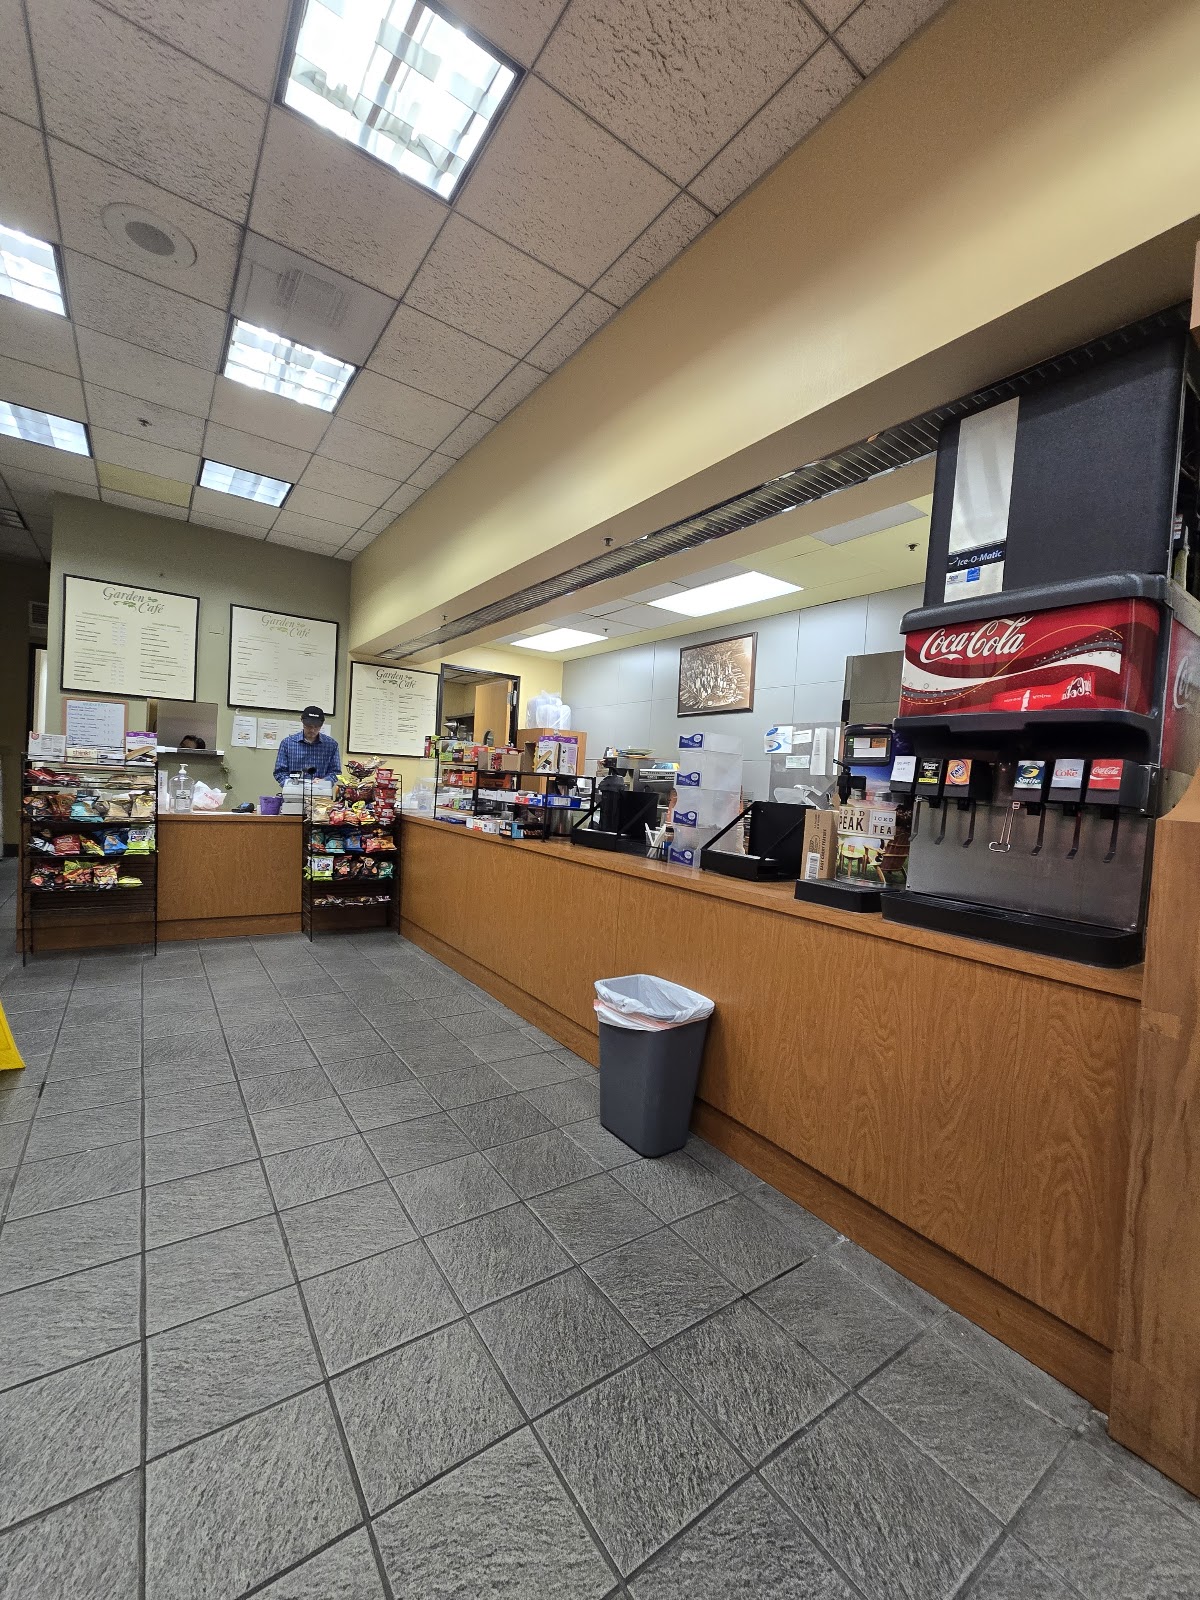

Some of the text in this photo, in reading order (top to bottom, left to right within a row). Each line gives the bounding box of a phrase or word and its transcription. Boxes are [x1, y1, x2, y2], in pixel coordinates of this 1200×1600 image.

[957, 550, 1003, 566] Ice-O-Matic
[103, 586, 145, 603] Garden
[138, 601, 165, 614] Café
[261, 614, 295, 628] Garden
[289, 627, 311, 639] Café
[919, 615, 1034, 664] Coca-Cola
[375, 668, 404, 680] Garden
[398, 679, 417, 689] Café
[1055, 768, 1078, 778] Coke
[1092, 766, 1121, 775] Coca-Cola
[1017, 776, 1042, 785] Sprite
[873, 824, 893, 835] TEA
